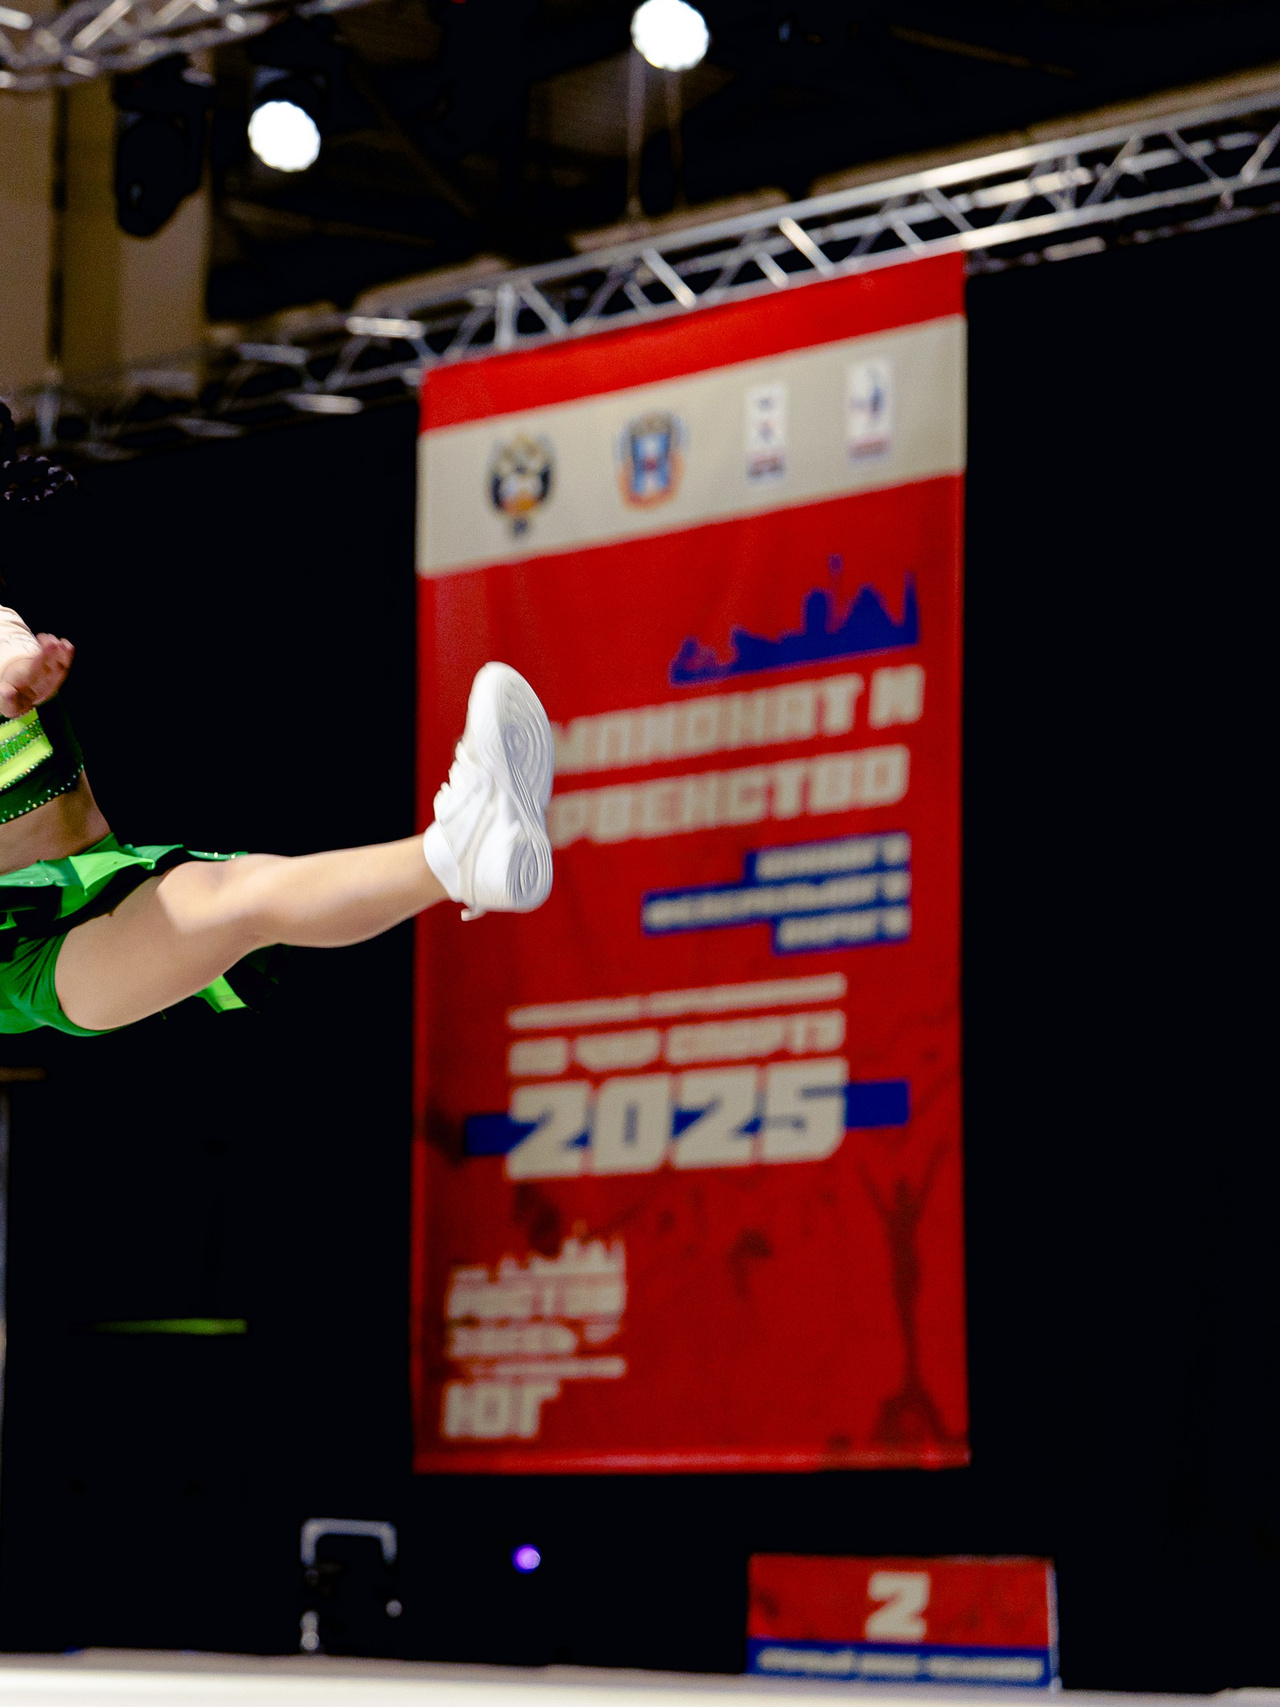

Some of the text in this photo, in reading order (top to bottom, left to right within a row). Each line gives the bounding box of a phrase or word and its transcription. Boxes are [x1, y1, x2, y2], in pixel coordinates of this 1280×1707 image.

[552, 674, 864, 776] МПИОНАТ
[550, 745, 911, 850] РВЕНСТВО
[506, 1056, 849, 1181] 2025
[443, 1380, 561, 1440] ЮГ
[865, 1571, 931, 1644] 2
